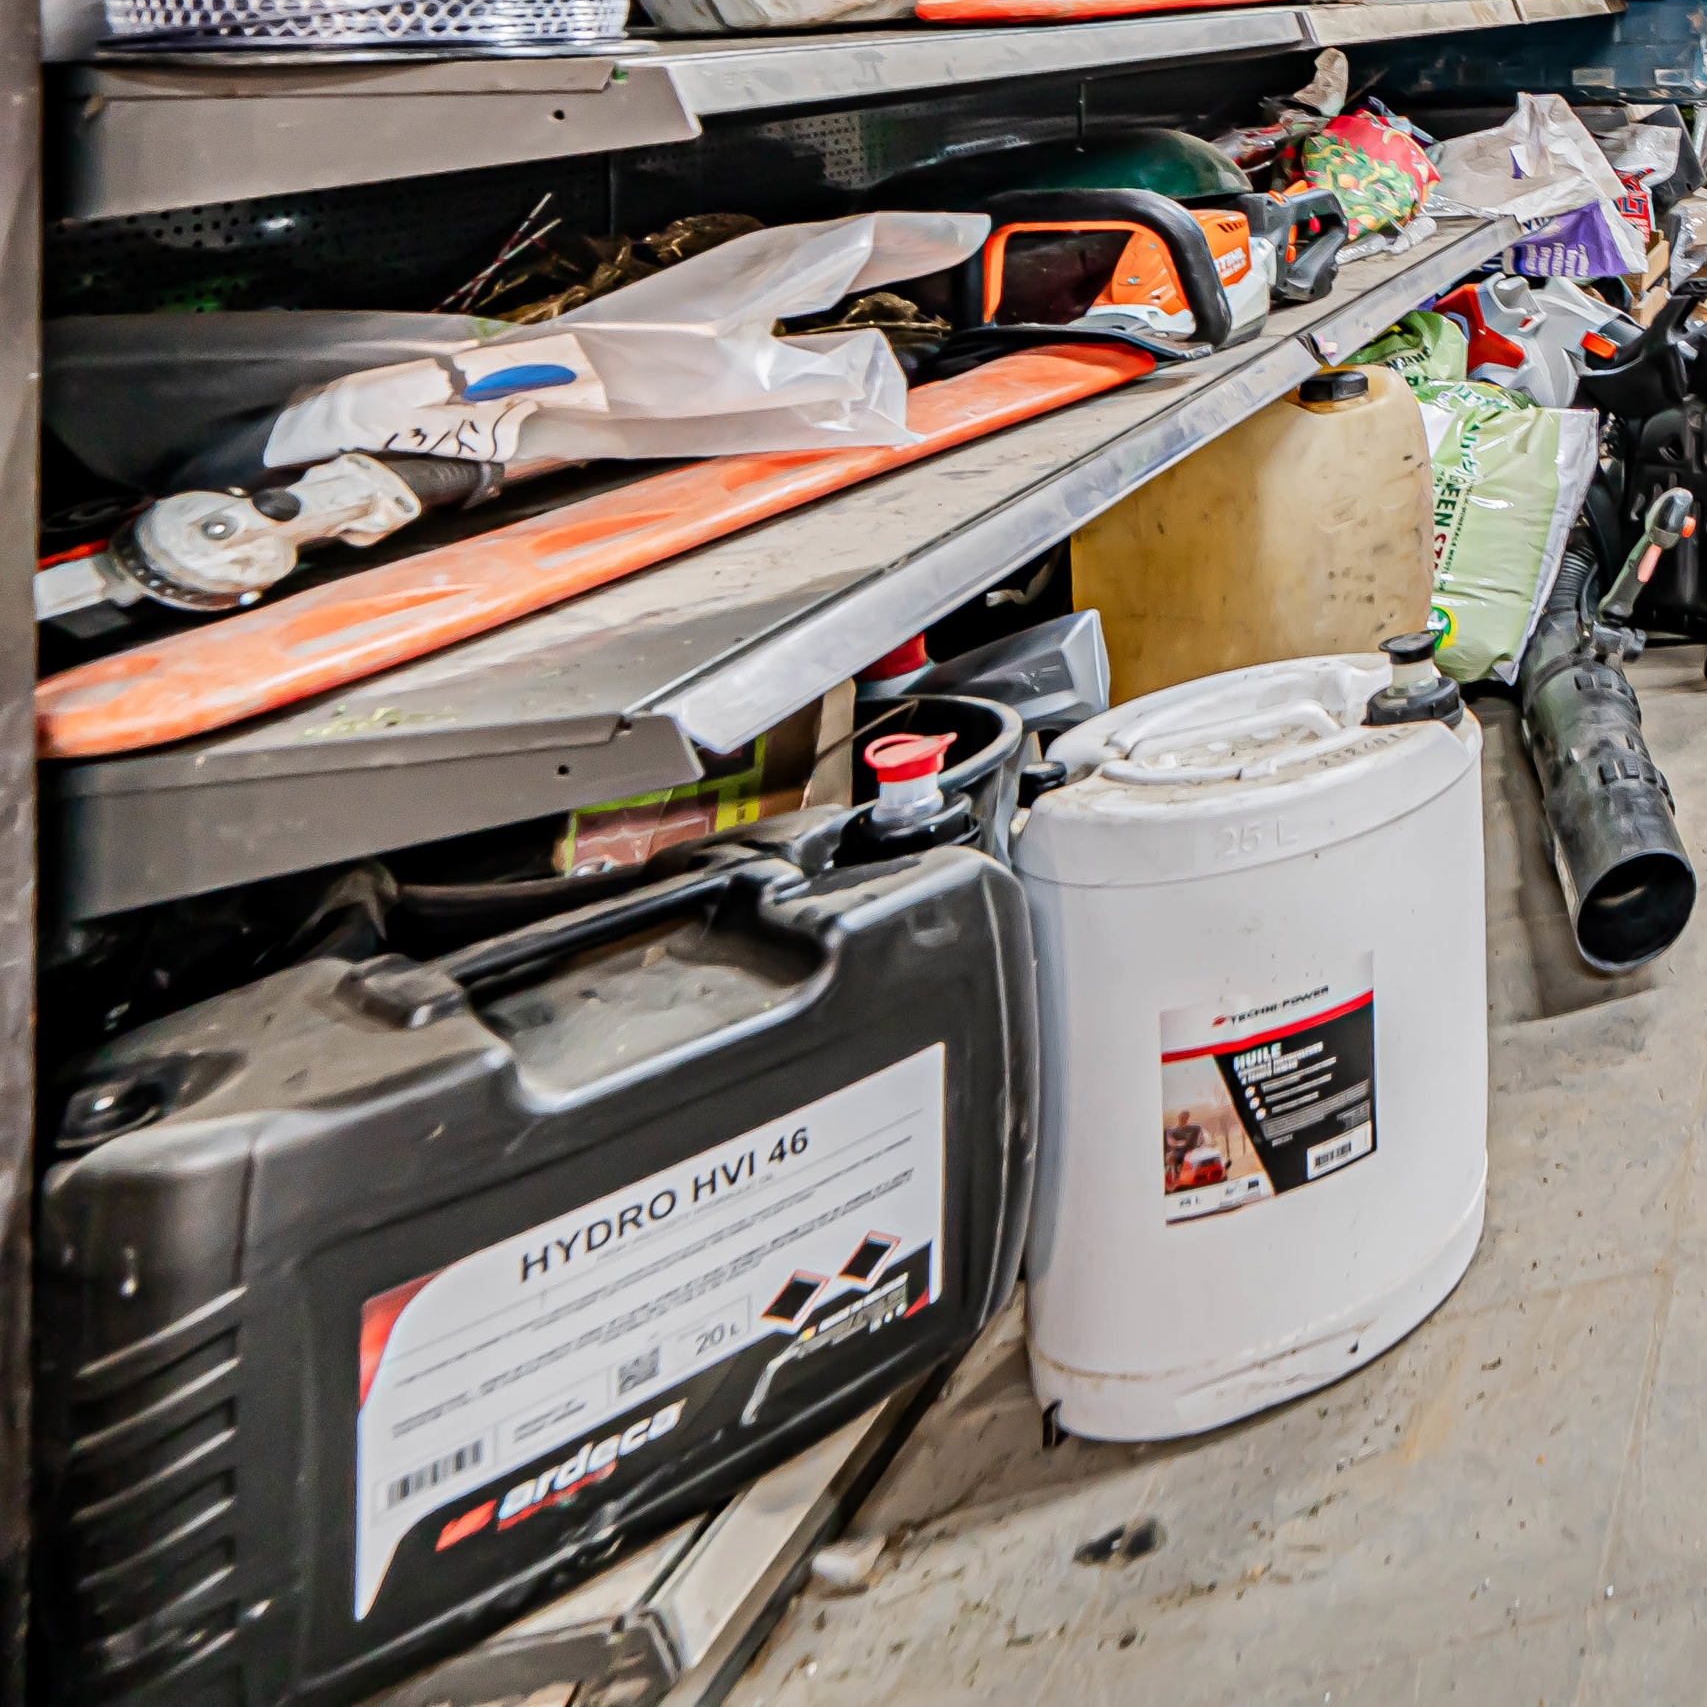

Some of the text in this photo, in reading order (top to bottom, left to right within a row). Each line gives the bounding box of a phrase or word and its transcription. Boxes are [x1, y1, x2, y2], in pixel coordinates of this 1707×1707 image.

[518, 1188, 679, 1284] HYDRO
[692, 1150, 755, 1203] HVI
[767, 1126, 809, 1165] 46
[694, 1322, 726, 1357] 20
[497, 1397, 689, 1521] ardeca
